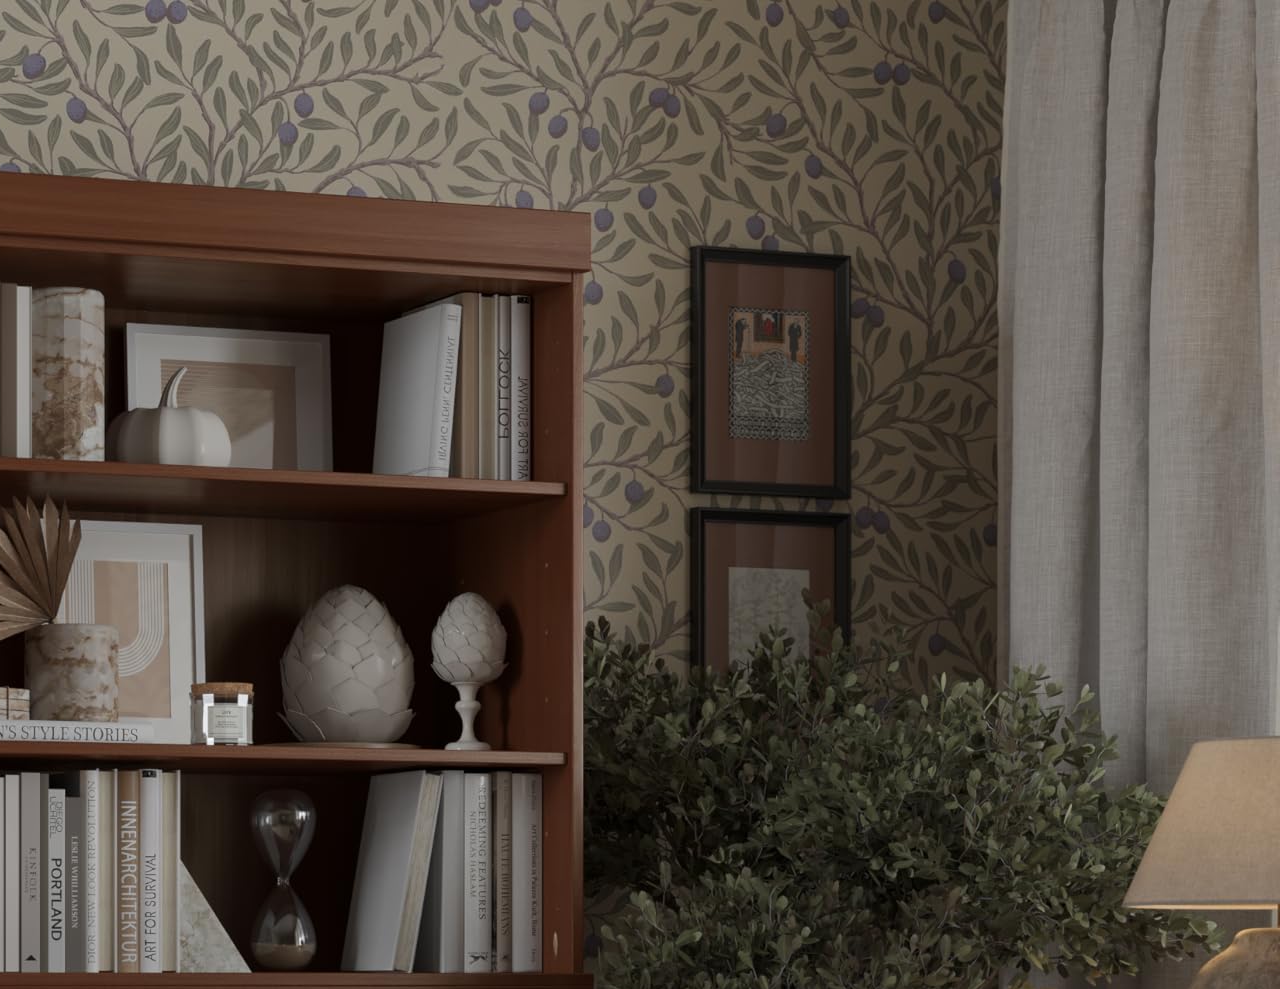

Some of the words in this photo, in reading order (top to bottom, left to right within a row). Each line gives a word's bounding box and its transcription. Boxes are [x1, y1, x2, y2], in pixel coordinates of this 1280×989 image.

[20, 724, 69, 739] STYLE
[74, 725, 138, 742] STORIES
[29, 848, 38, 902] KINFOLK
[71, 836, 81, 864] LESLIE
[51, 858, 62, 941] PORTLAND
[121, 801, 137, 962] INNENARCHITEKTUR
[144, 853, 157, 908] SURVIVAL
[477, 861, 487, 920] FEATURES
[144, 912, 157, 935] FOR
[144, 941, 157, 963] ART
